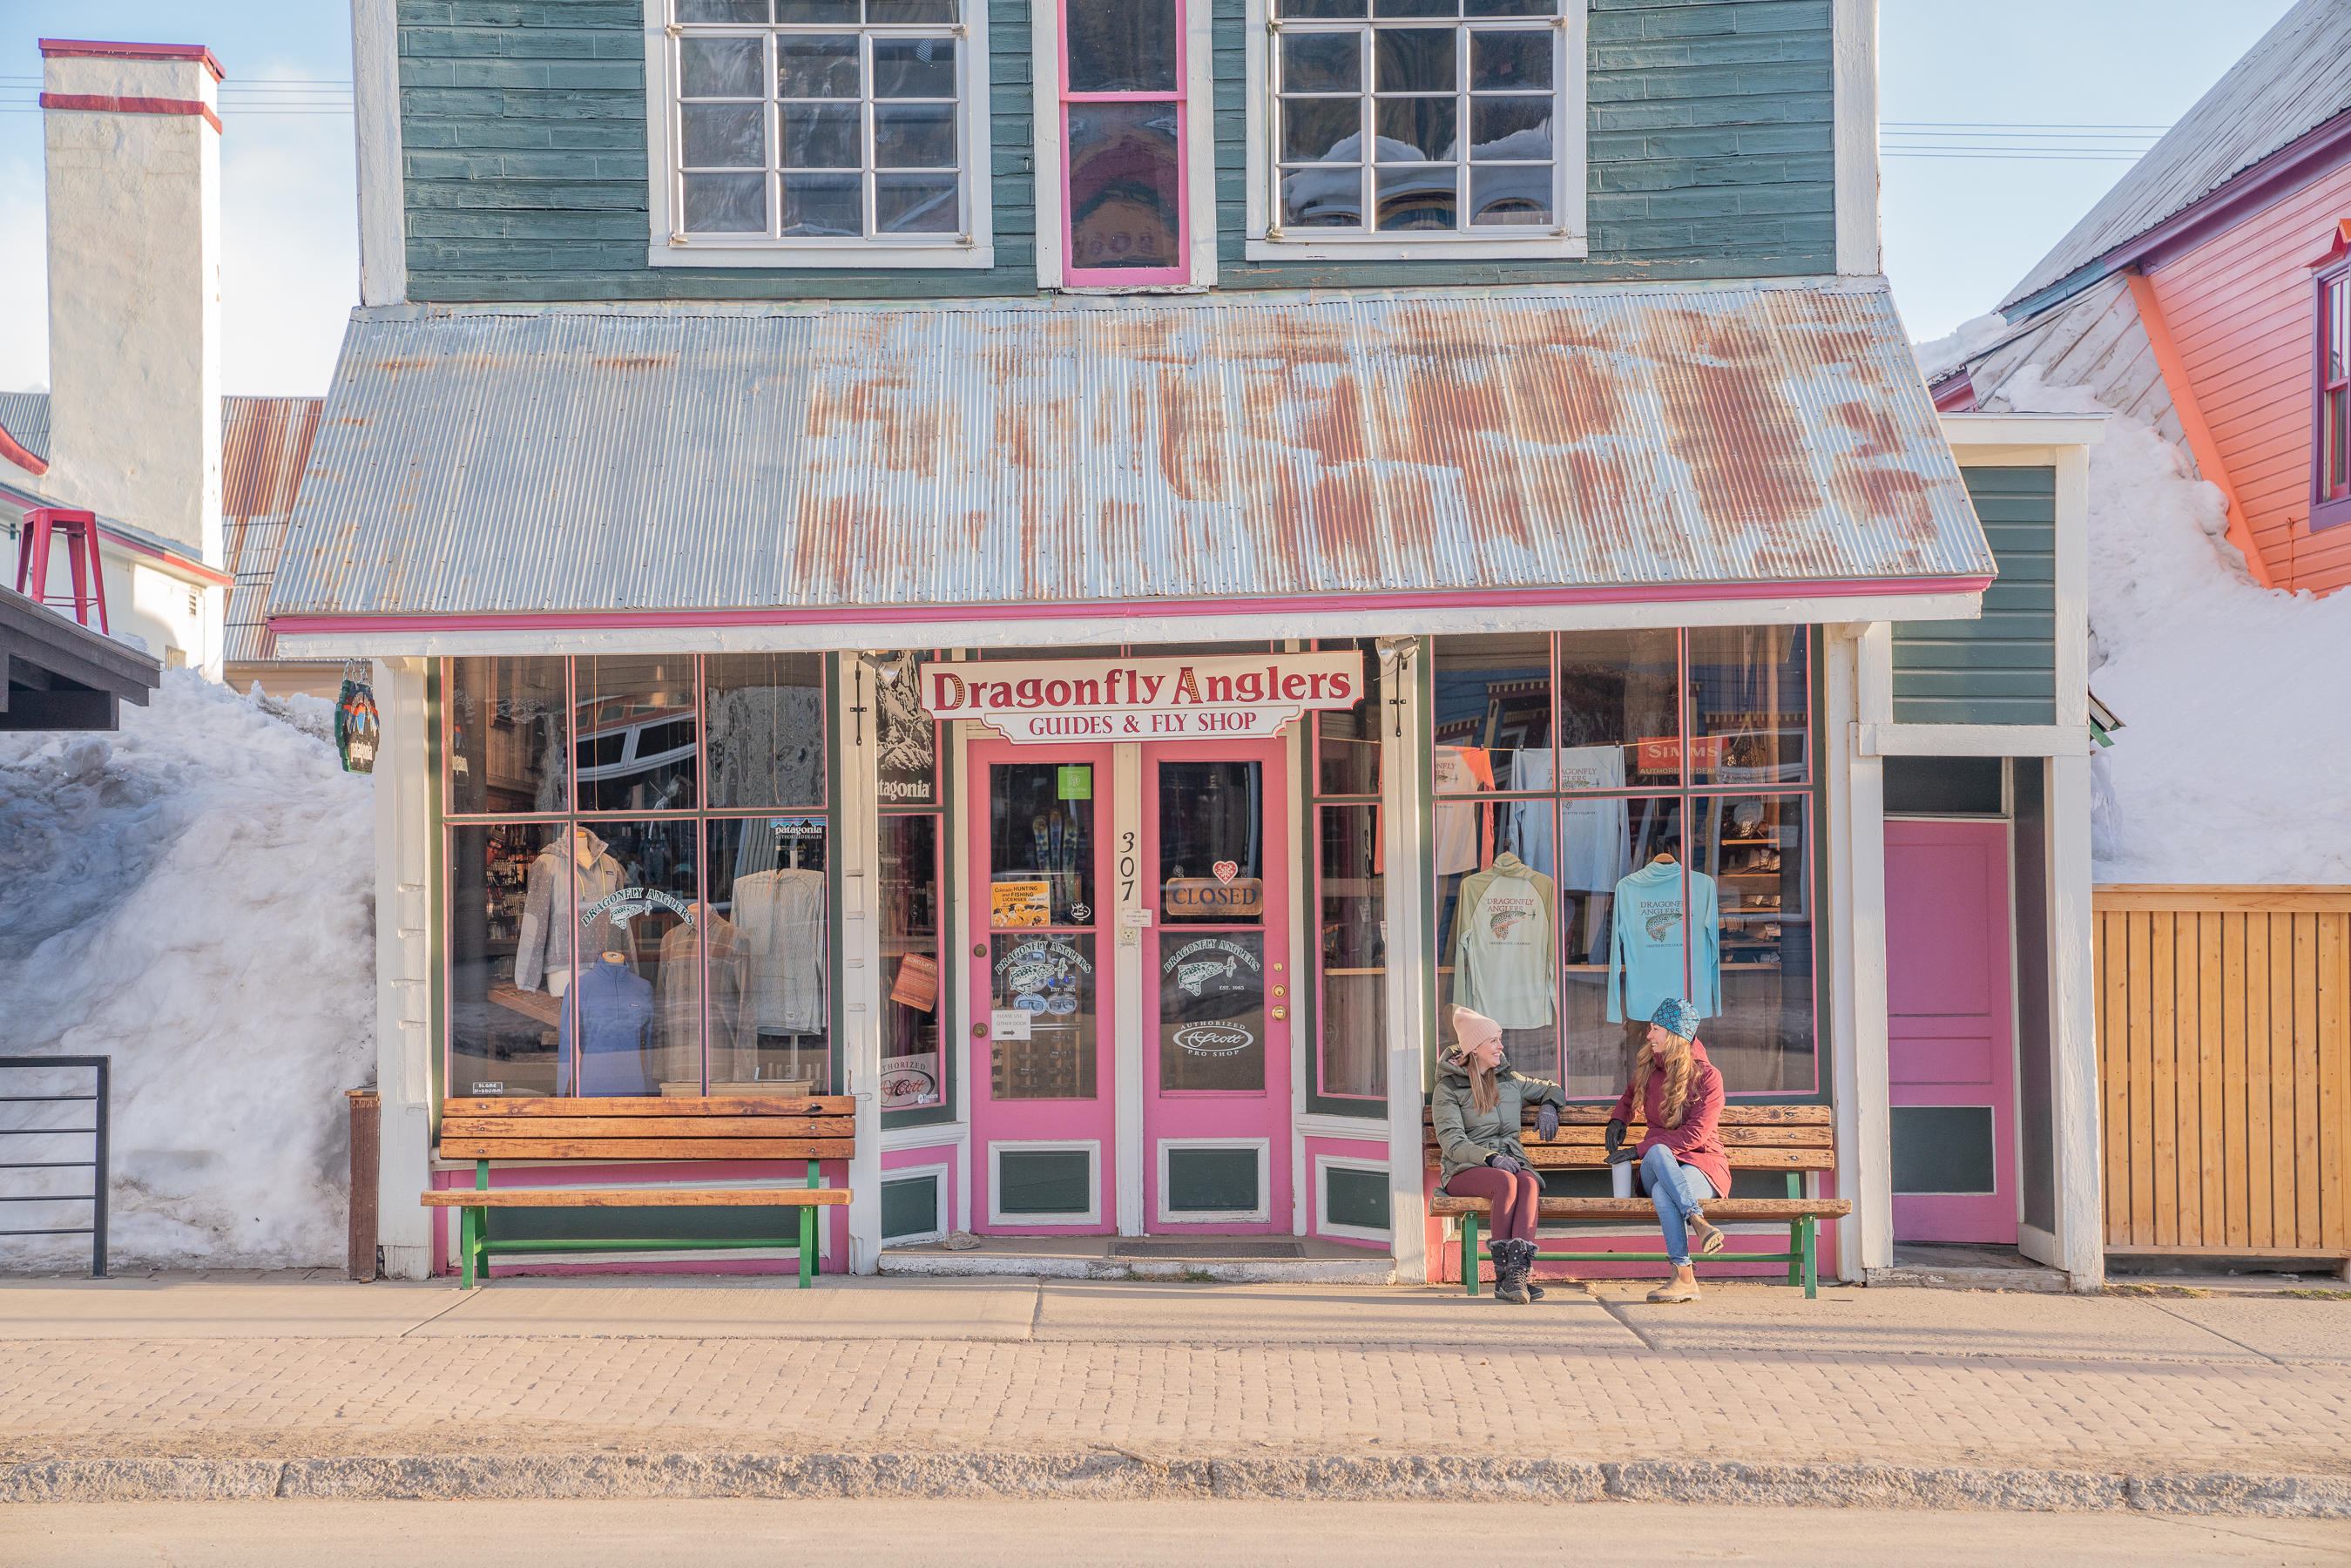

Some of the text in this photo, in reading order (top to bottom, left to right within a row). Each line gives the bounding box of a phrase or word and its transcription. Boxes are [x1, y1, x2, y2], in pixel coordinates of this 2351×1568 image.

[932, 666, 1351, 711] Dragonfly Anglers
[1029, 712, 1257, 735] GUIDES & FLY SHOP
[774, 826, 822, 835] patagonia
[1119, 831, 1135, 902] 307
[1172, 888, 1257, 905] CLOSED
[581, 887, 695, 927] DRAGONFLY ANGLERS
[906, 956, 922, 965] ECHO
[995, 940, 1092, 976] DRAGONFLY ANGLERS
[1163, 938, 1260, 974] DRAGONFLY ANGLERS
[1180, 1020, 1246, 1030] AUTHORIZED
[1184, 1031, 1245, 1048] Scott
[882, 1061, 926, 1071] THORIZED
